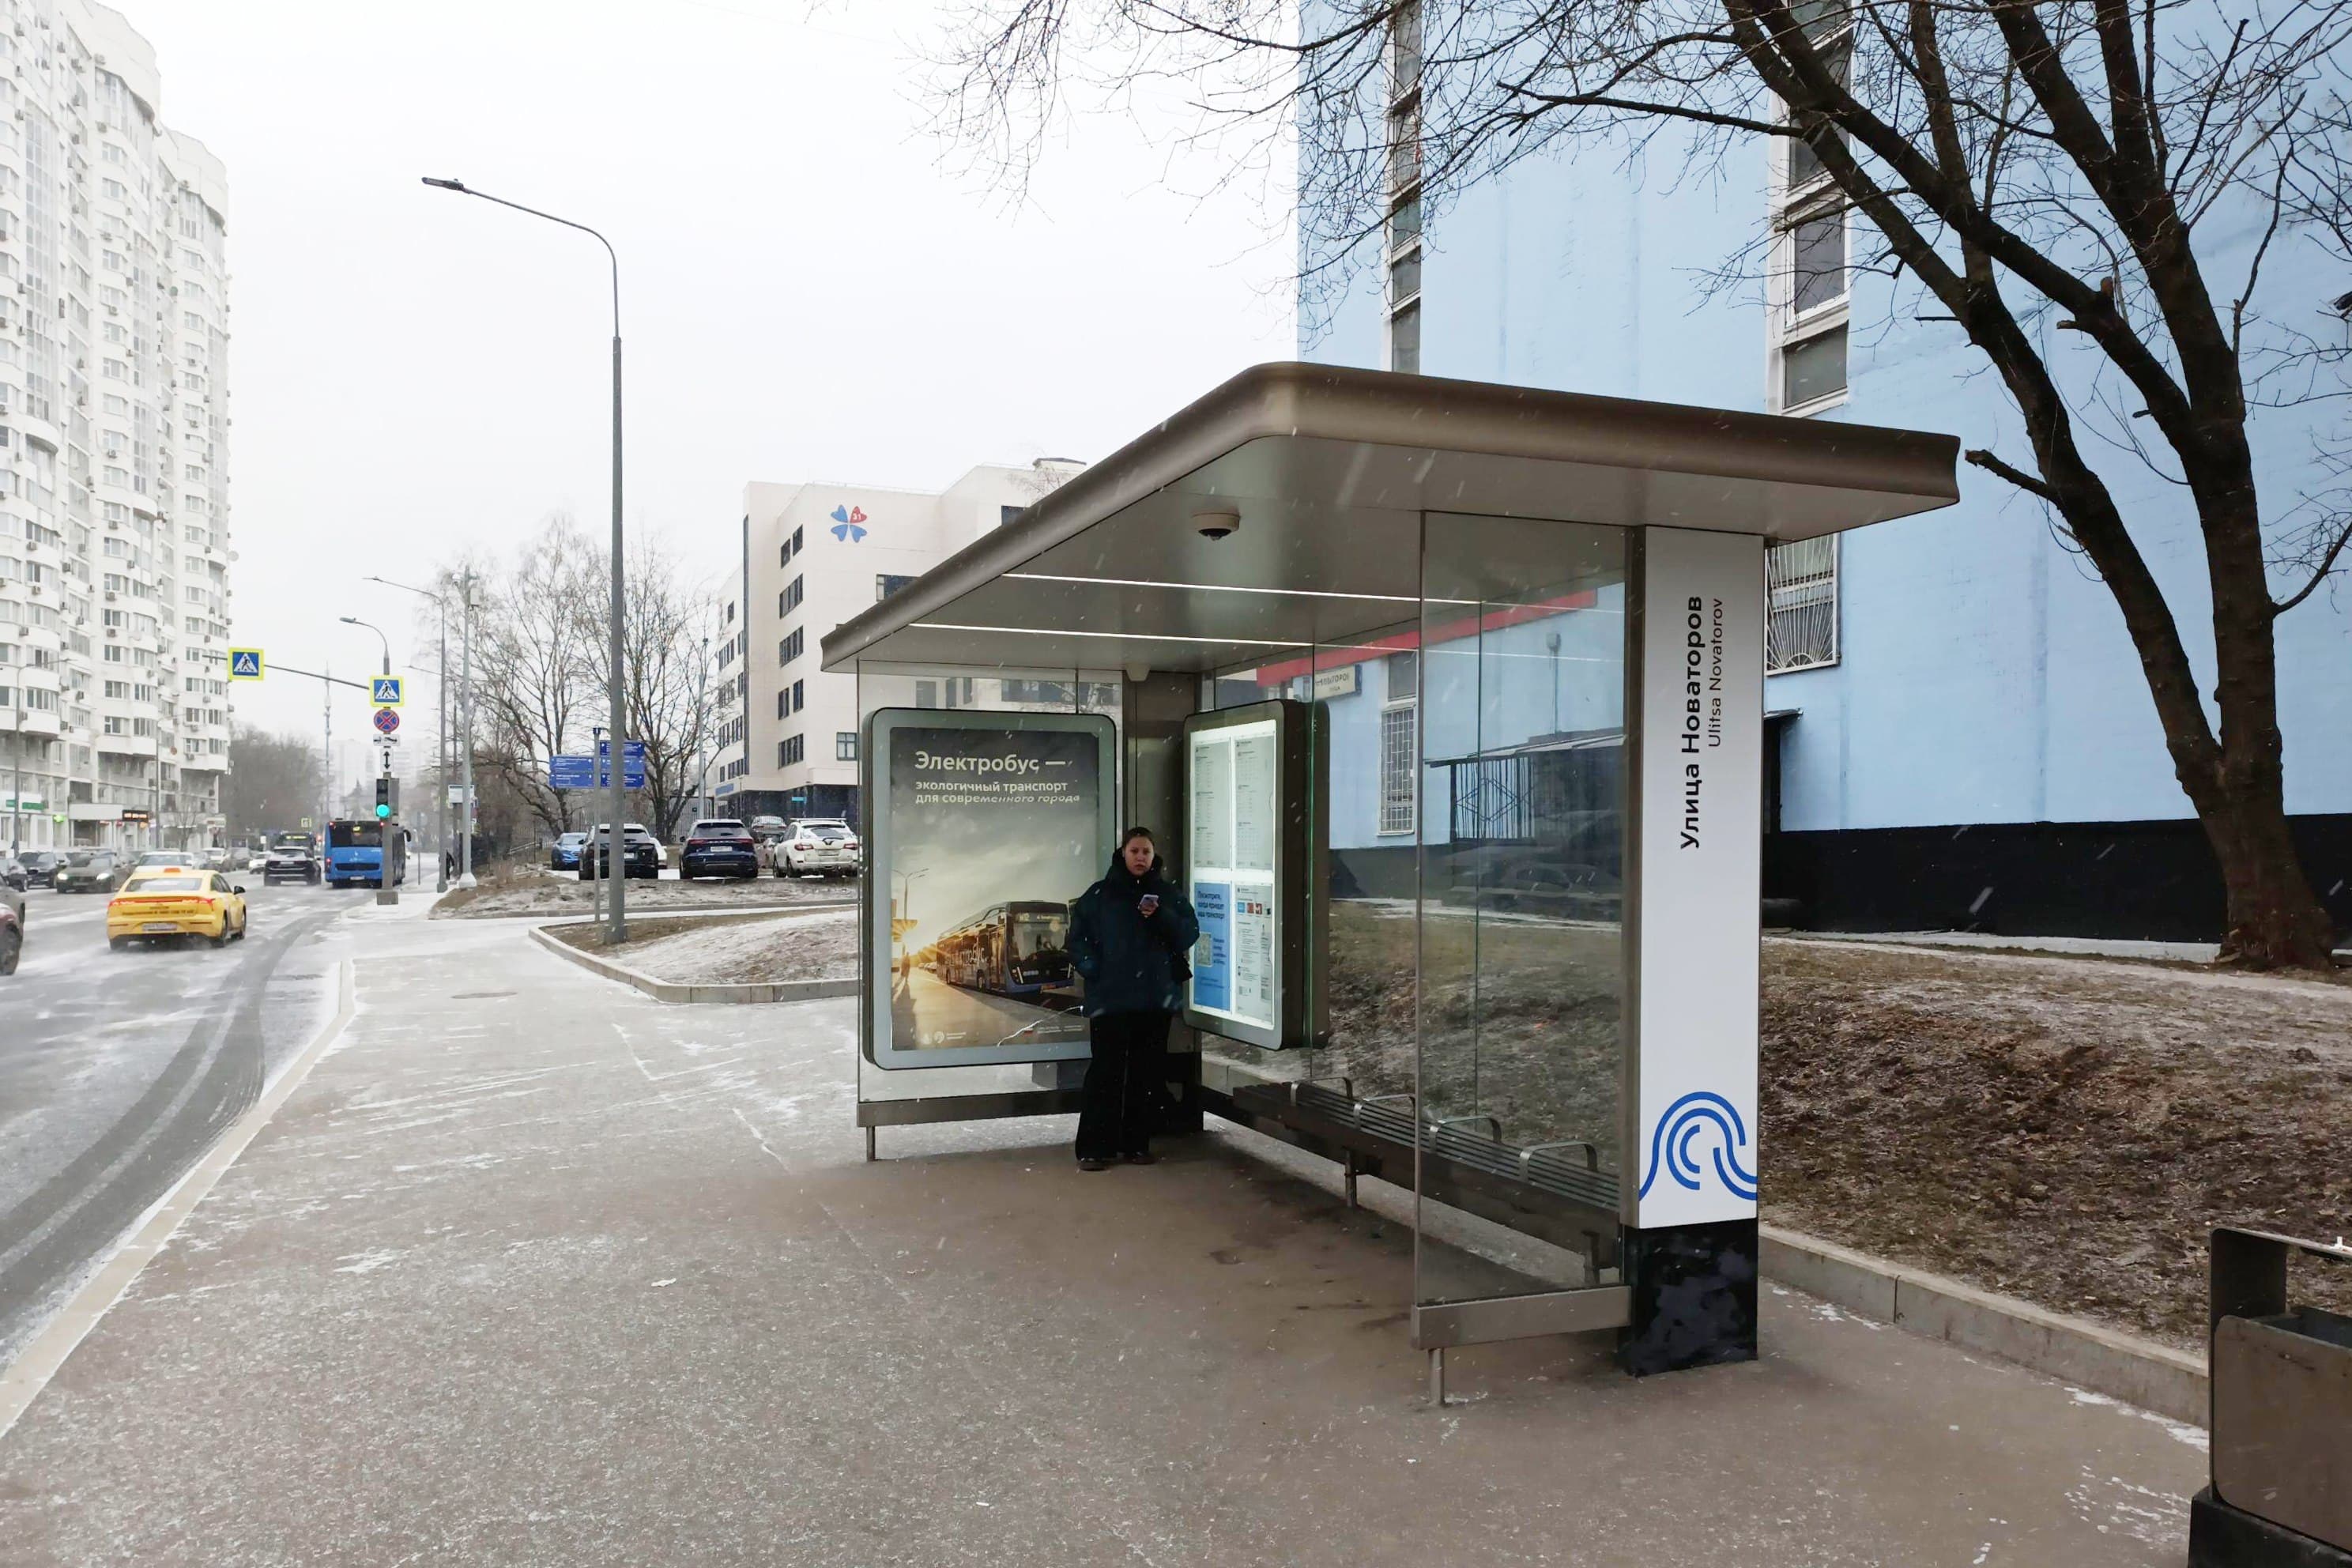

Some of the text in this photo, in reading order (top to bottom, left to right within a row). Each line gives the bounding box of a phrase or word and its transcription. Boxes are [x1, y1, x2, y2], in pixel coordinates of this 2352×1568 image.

[1708, 597, 1723, 747] Ulitsa Novatorov
[1680, 596, 1706, 850] Улица Новаторов
[914, 751, 1039, 775] Электробус
[915, 781, 1069, 794] экологичный транспорт
[915, 794, 939, 805] для
[1037, 794, 1080, 805] города
